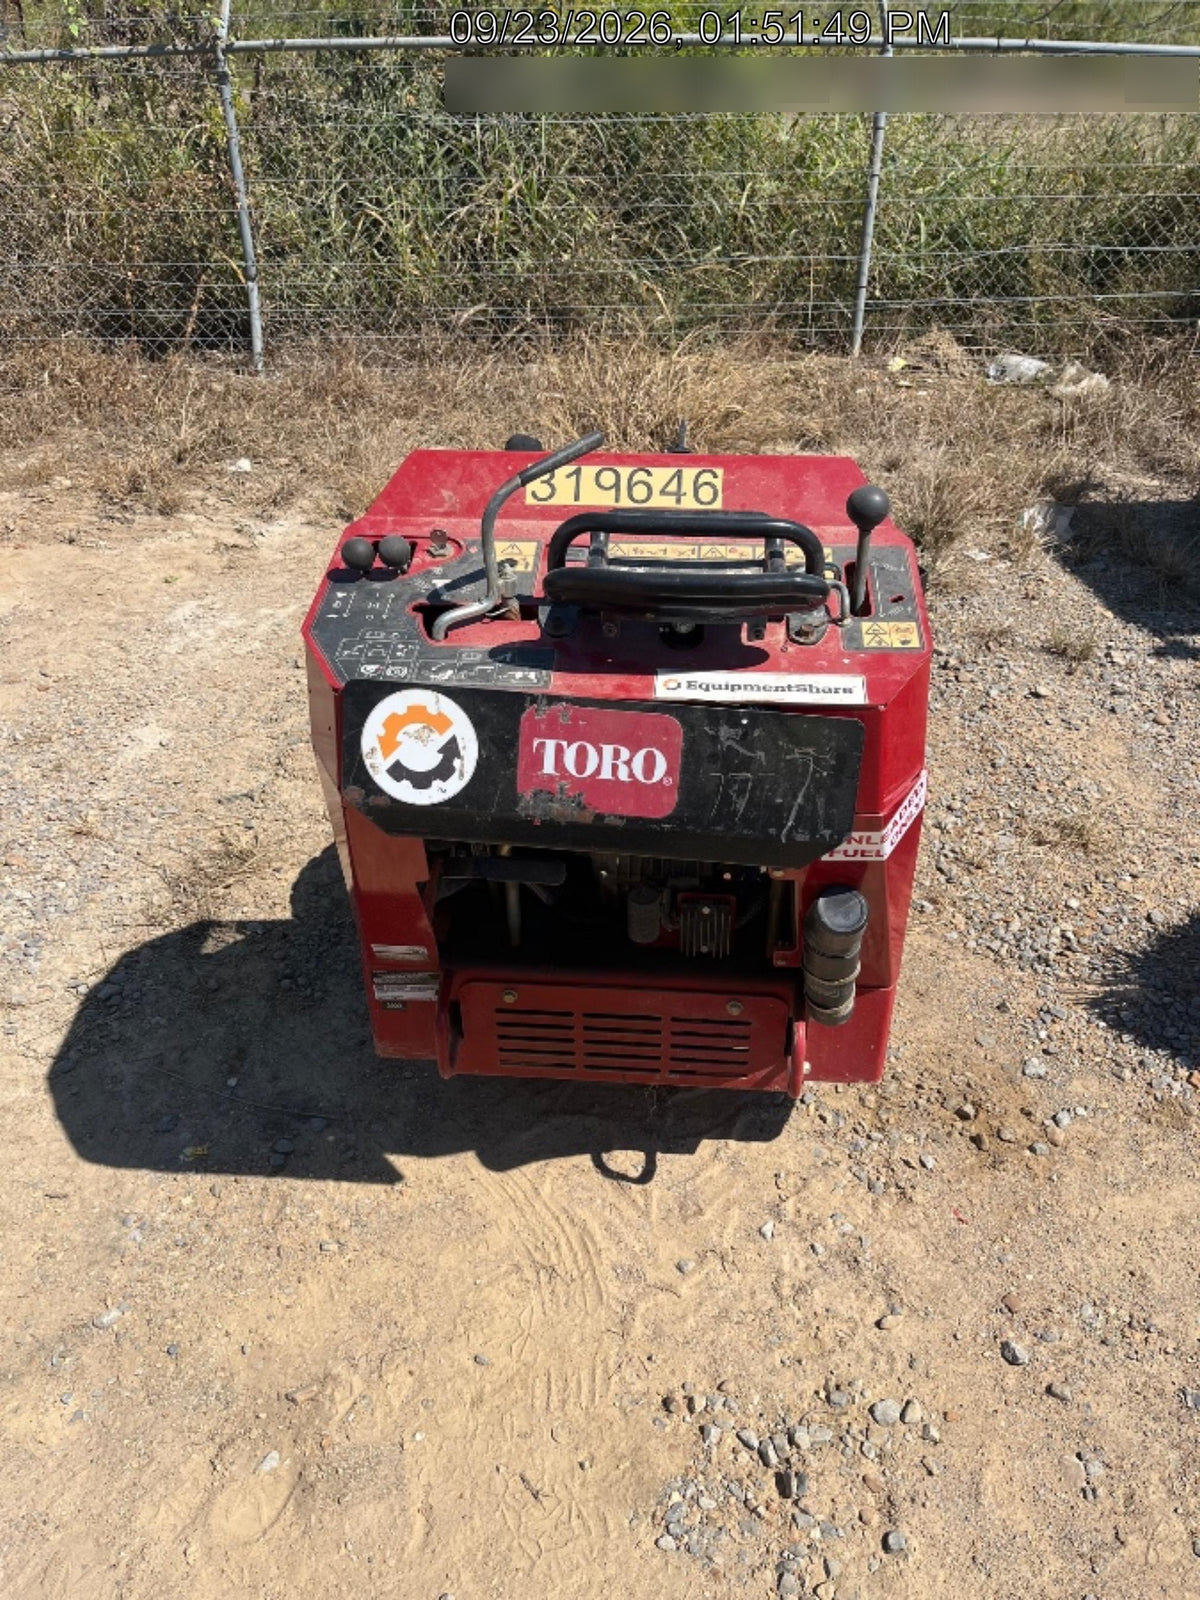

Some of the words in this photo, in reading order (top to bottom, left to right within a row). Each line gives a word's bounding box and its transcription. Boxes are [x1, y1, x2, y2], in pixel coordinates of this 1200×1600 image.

[531, 466, 719, 506] 319646
[685, 679, 854, 695] EquipmentShare
[532, 736, 669, 785] TORO
[845, 781, 924, 845] NLEADED
